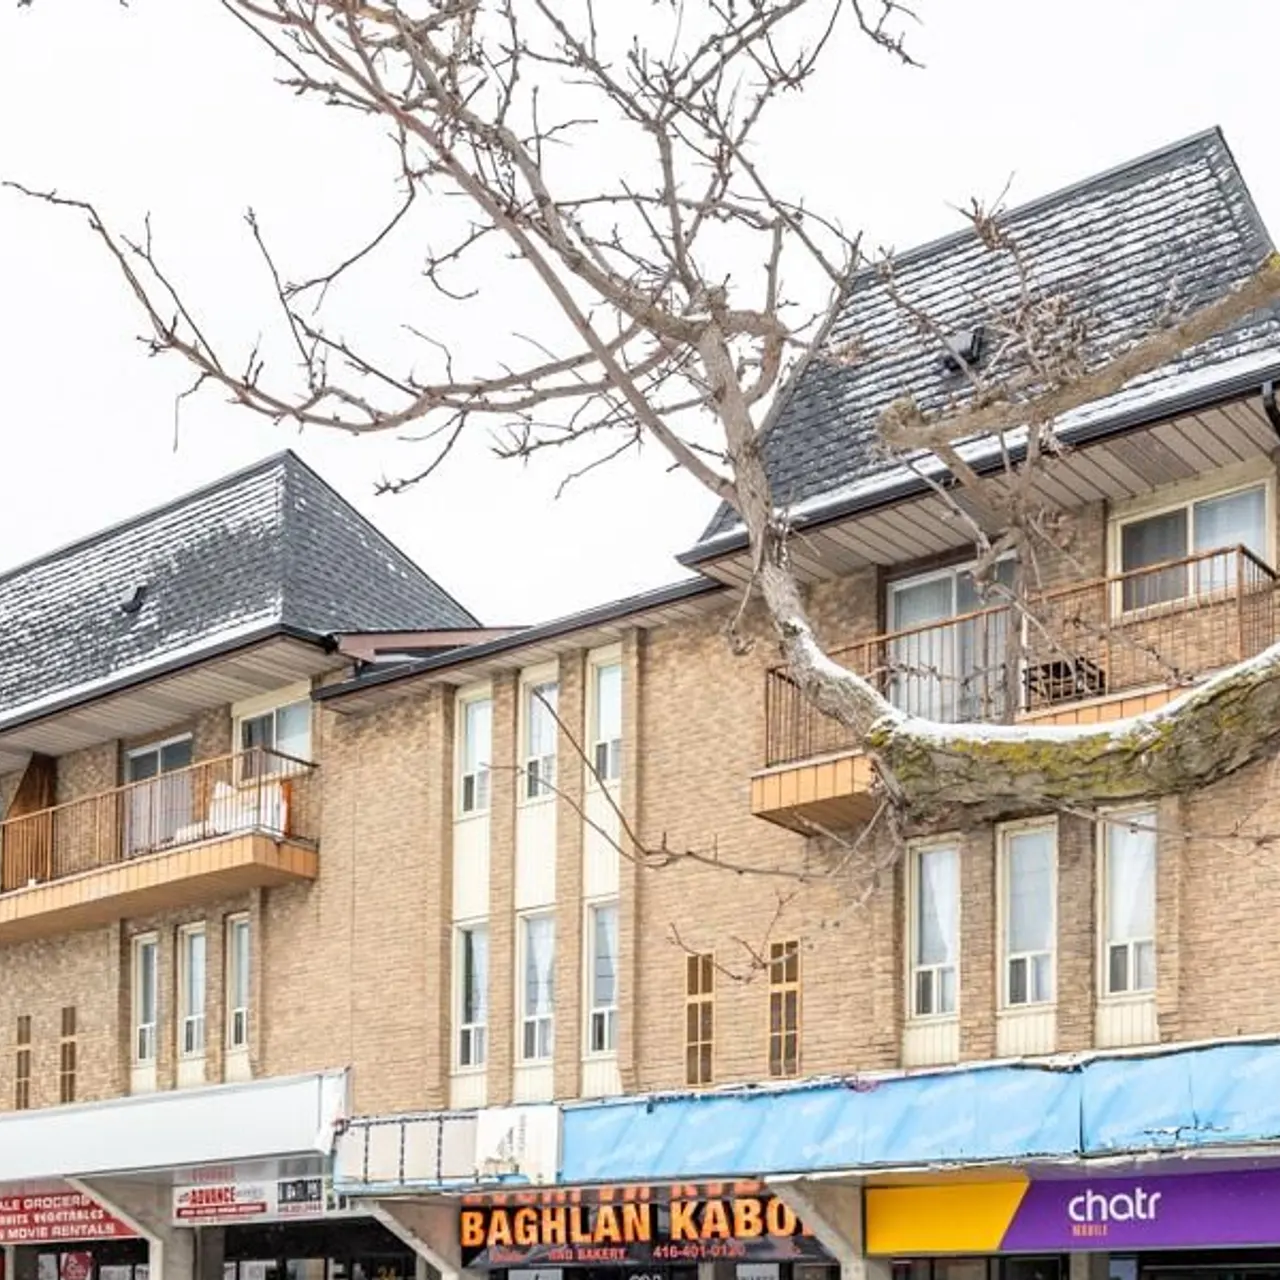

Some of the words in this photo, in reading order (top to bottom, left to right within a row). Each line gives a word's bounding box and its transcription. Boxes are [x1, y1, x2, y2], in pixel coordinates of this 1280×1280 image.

[33, 1209, 104, 1223] VEGETABLES
[1068, 1186, 1162, 1222] chatr
[7, 1226, 49, 1239] MOVIE
[51, 1222, 116, 1237] RENTALS
[460, 1202, 652, 1248] BAGHLAN
